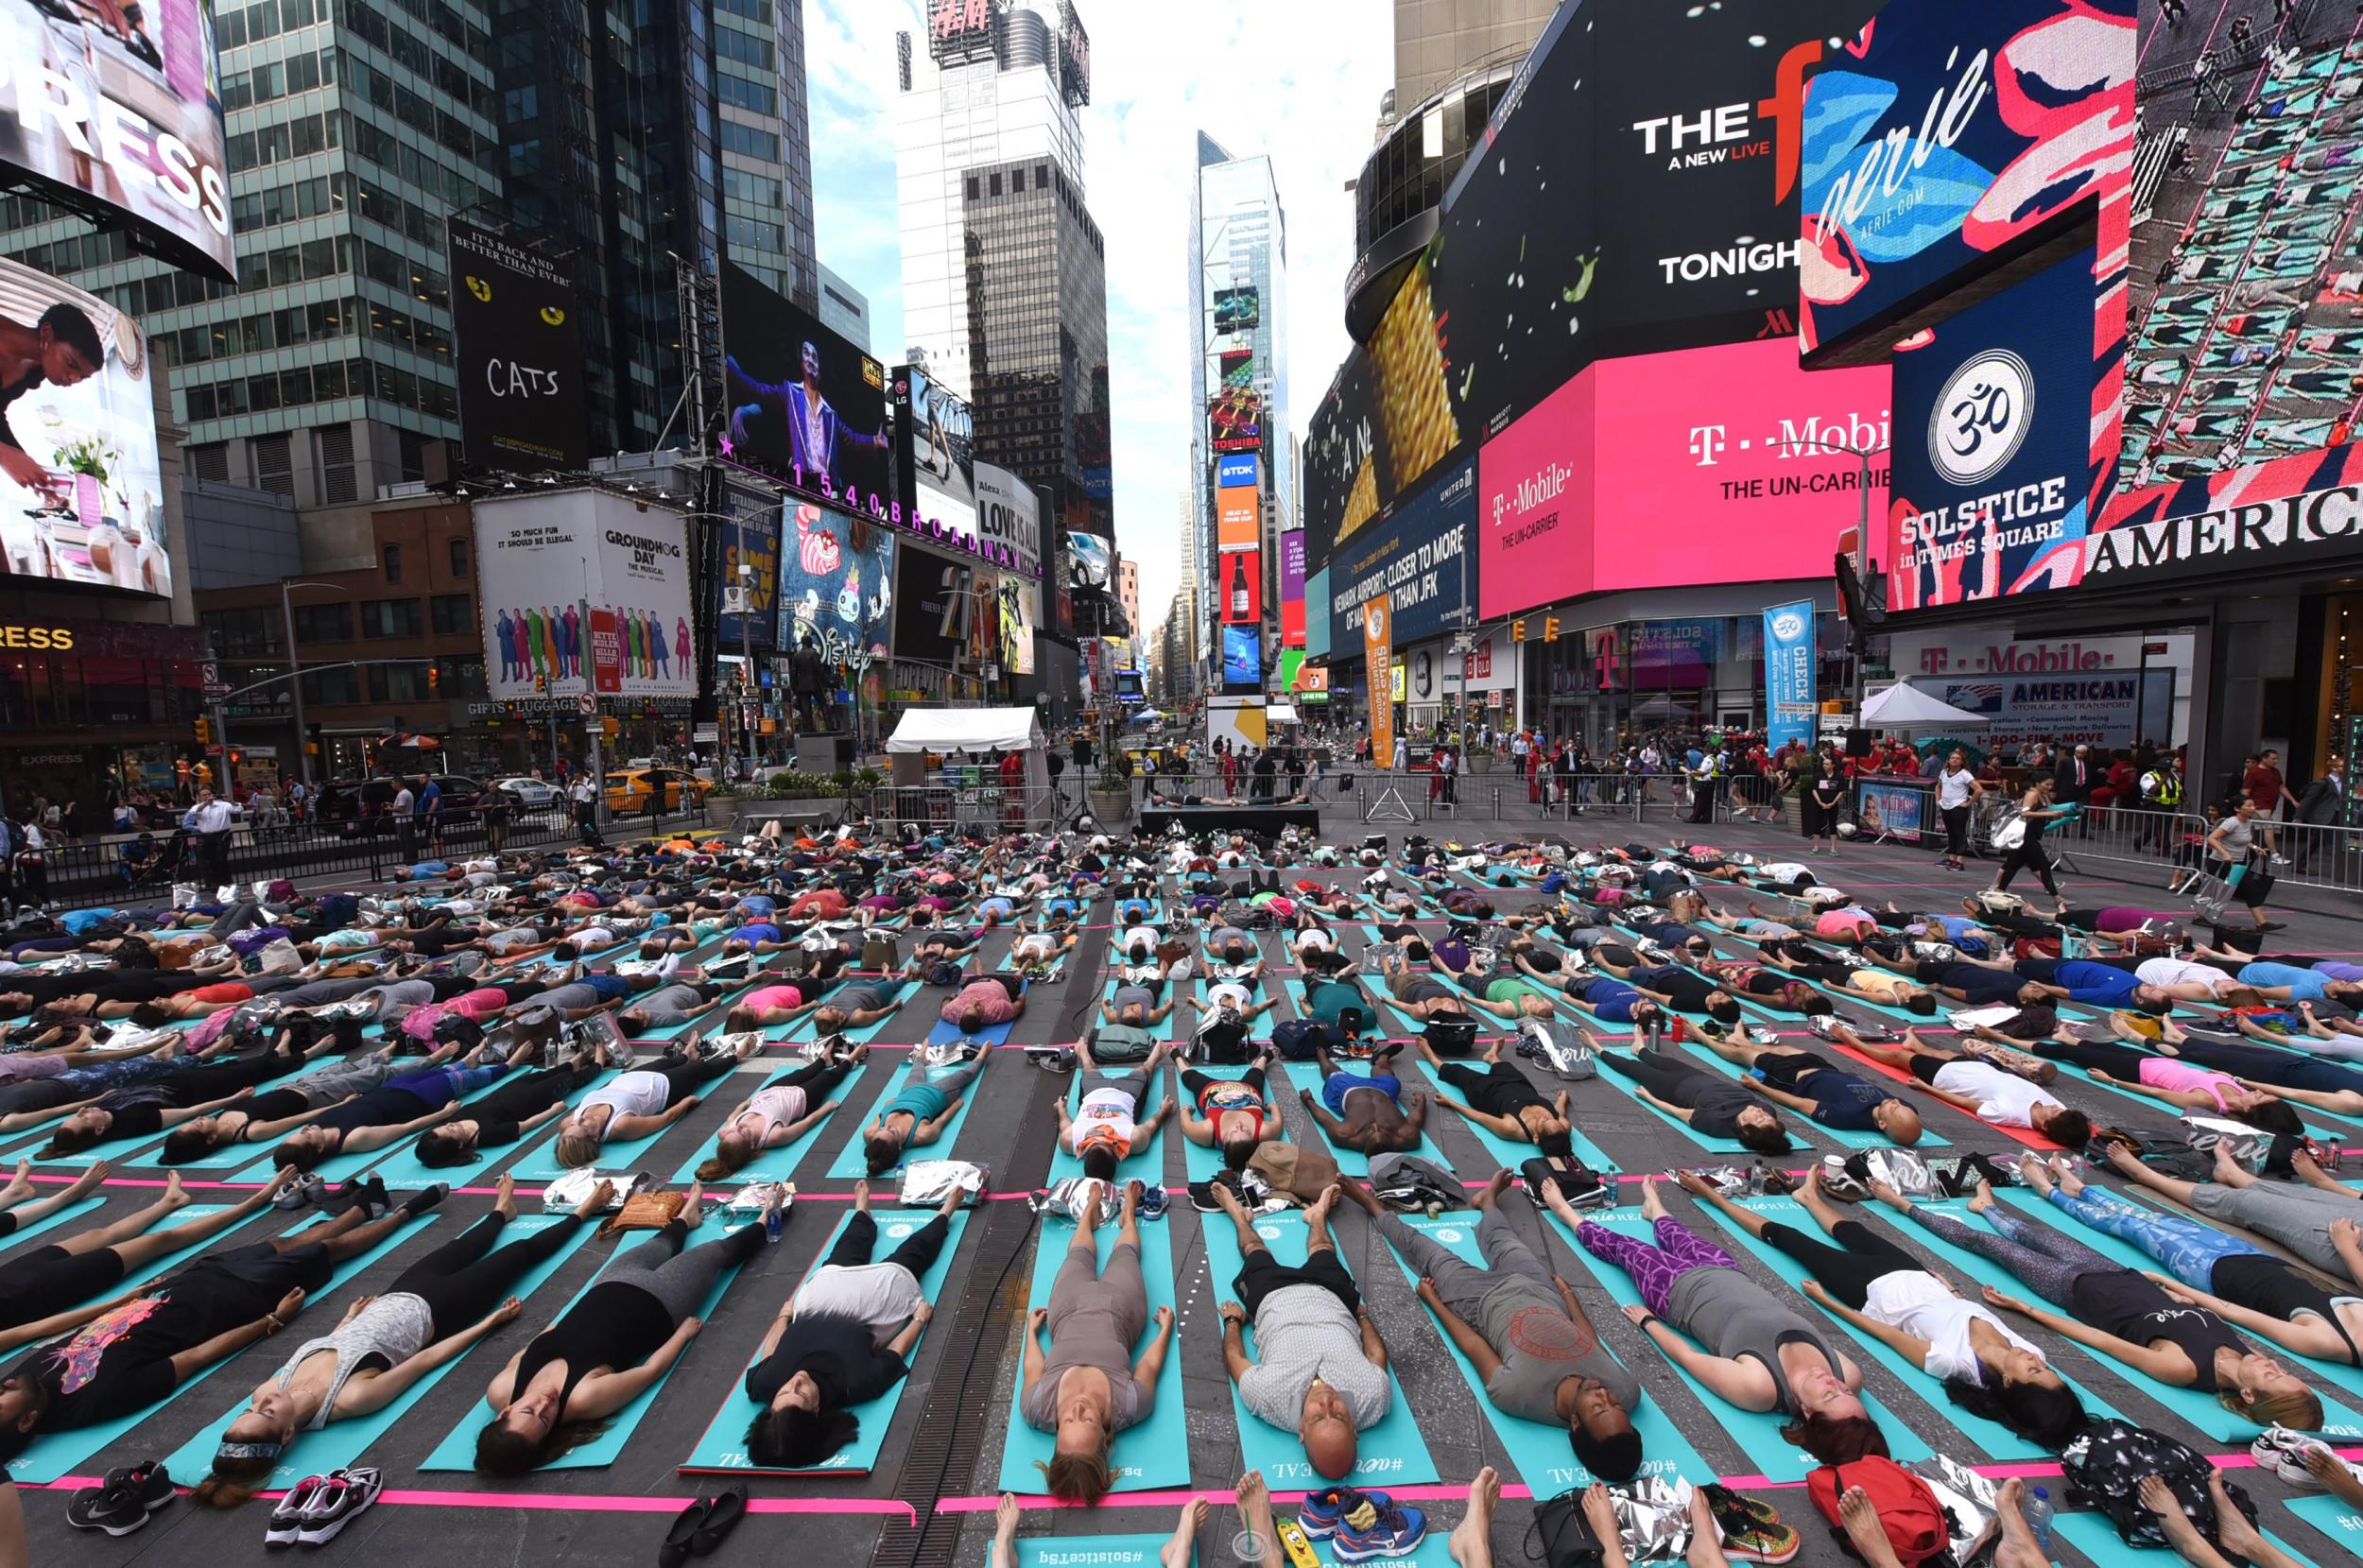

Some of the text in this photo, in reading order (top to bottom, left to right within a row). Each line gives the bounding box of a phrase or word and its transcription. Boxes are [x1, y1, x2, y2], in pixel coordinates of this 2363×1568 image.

[1633, 102, 1750, 155] THE
[1668, 141, 1770, 171] A NEW LIVE
[1815, 45, 1989, 247] aerie
[1861, 185, 1924, 242] AERIE.COM
[472, 232, 494, 248] IT'S
[497, 241, 527, 262] BACK
[530, 256, 554, 271] AND
[503, 254, 536, 275] THAN
[487, 358, 559, 398] CATS
[896, 396, 907, 405] LG
[1214, 438, 1262, 449] TOSHIBA
[1230, 465, 1253, 474] TDK
[1440, 478, 1464, 502] UNITED
[1720, 479, 1763, 500] THE
[1900, 475, 2065, 545] SOLSTICE
[523, 528, 543, 537] MUCH
[545, 526, 559, 535] FUN
[979, 499, 1016, 542] LOVE
[1017, 513, 1025, 547] IS
[1026, 521, 1038, 556] ALL
[508, 538, 533, 548] SHOULD
[535, 537, 544, 545] BE
[606, 529, 681, 558] GROUNDHOG
[1502, 532, 1514, 550] THE
[1899, 519, 2063, 569] in TIMES SQUARE
[634, 549, 655, 565] DAY
[628, 562, 664, 575] THE MUSICAL
[1334, 586, 1357, 615] NEWARK
[1387, 553, 1418, 588] CLOSER
[1418, 543, 1431, 572] TO
[1433, 526, 1464, 564] MORE
[1395, 580, 1418, 612] THAN
[1420, 571, 1438, 602] JFK
[1346, 610, 1357, 630] OF
[1595, 631, 1619, 688] T
[1793, 646, 1809, 700] CHECK
[614, 696, 693, 707] GIFTS LUGGAGE
[2010, 679, 2137, 703] AMERICAN
[468, 698, 578, 715] GIFTS LUGGAGE
[2011, 702, 2058, 711] STORAGE
[2073, 701, 2132, 710] TRANSPORT
[2079, 715, 2110, 723] Moving
[21, 754, 83, 765] EXPRESS
[1039, 1551, 1144, 1565] #SolsticeTSq
